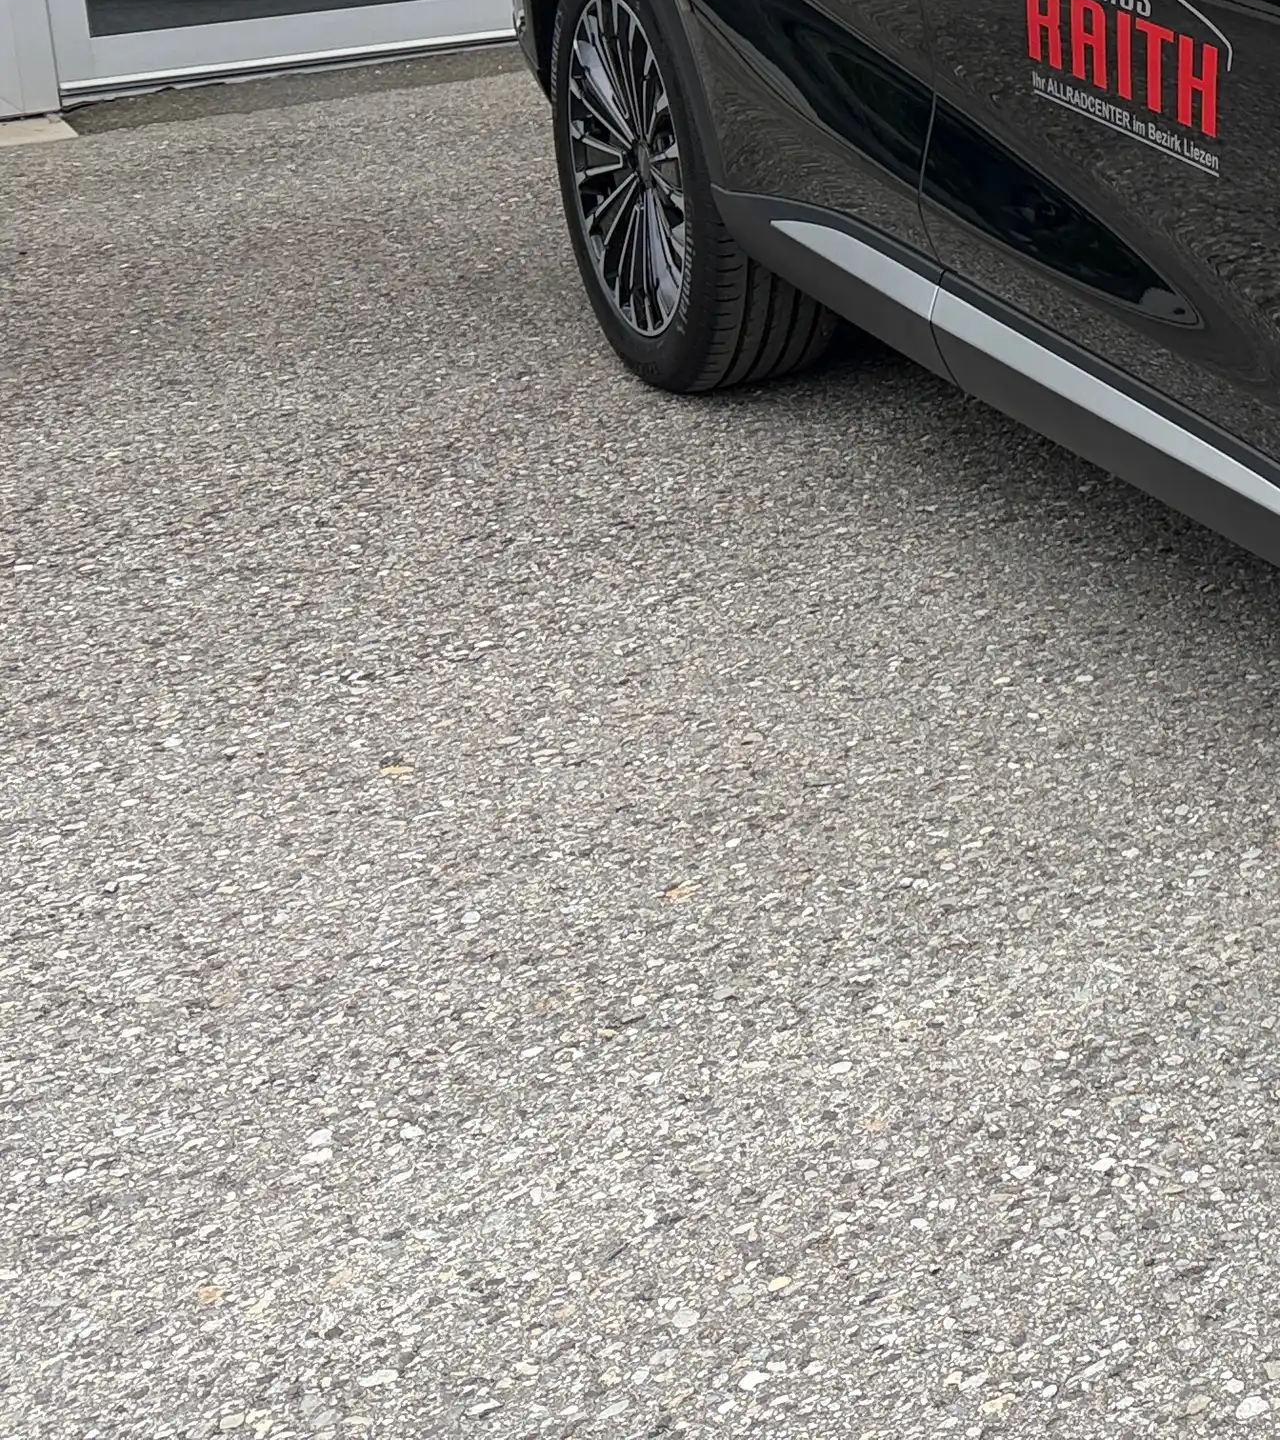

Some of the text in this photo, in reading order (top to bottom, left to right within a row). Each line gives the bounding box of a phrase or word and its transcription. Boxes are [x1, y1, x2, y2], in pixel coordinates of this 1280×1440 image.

[1032, 70, 1220, 170] Ihr ALLRADCENTER im Bezirk Liezen
